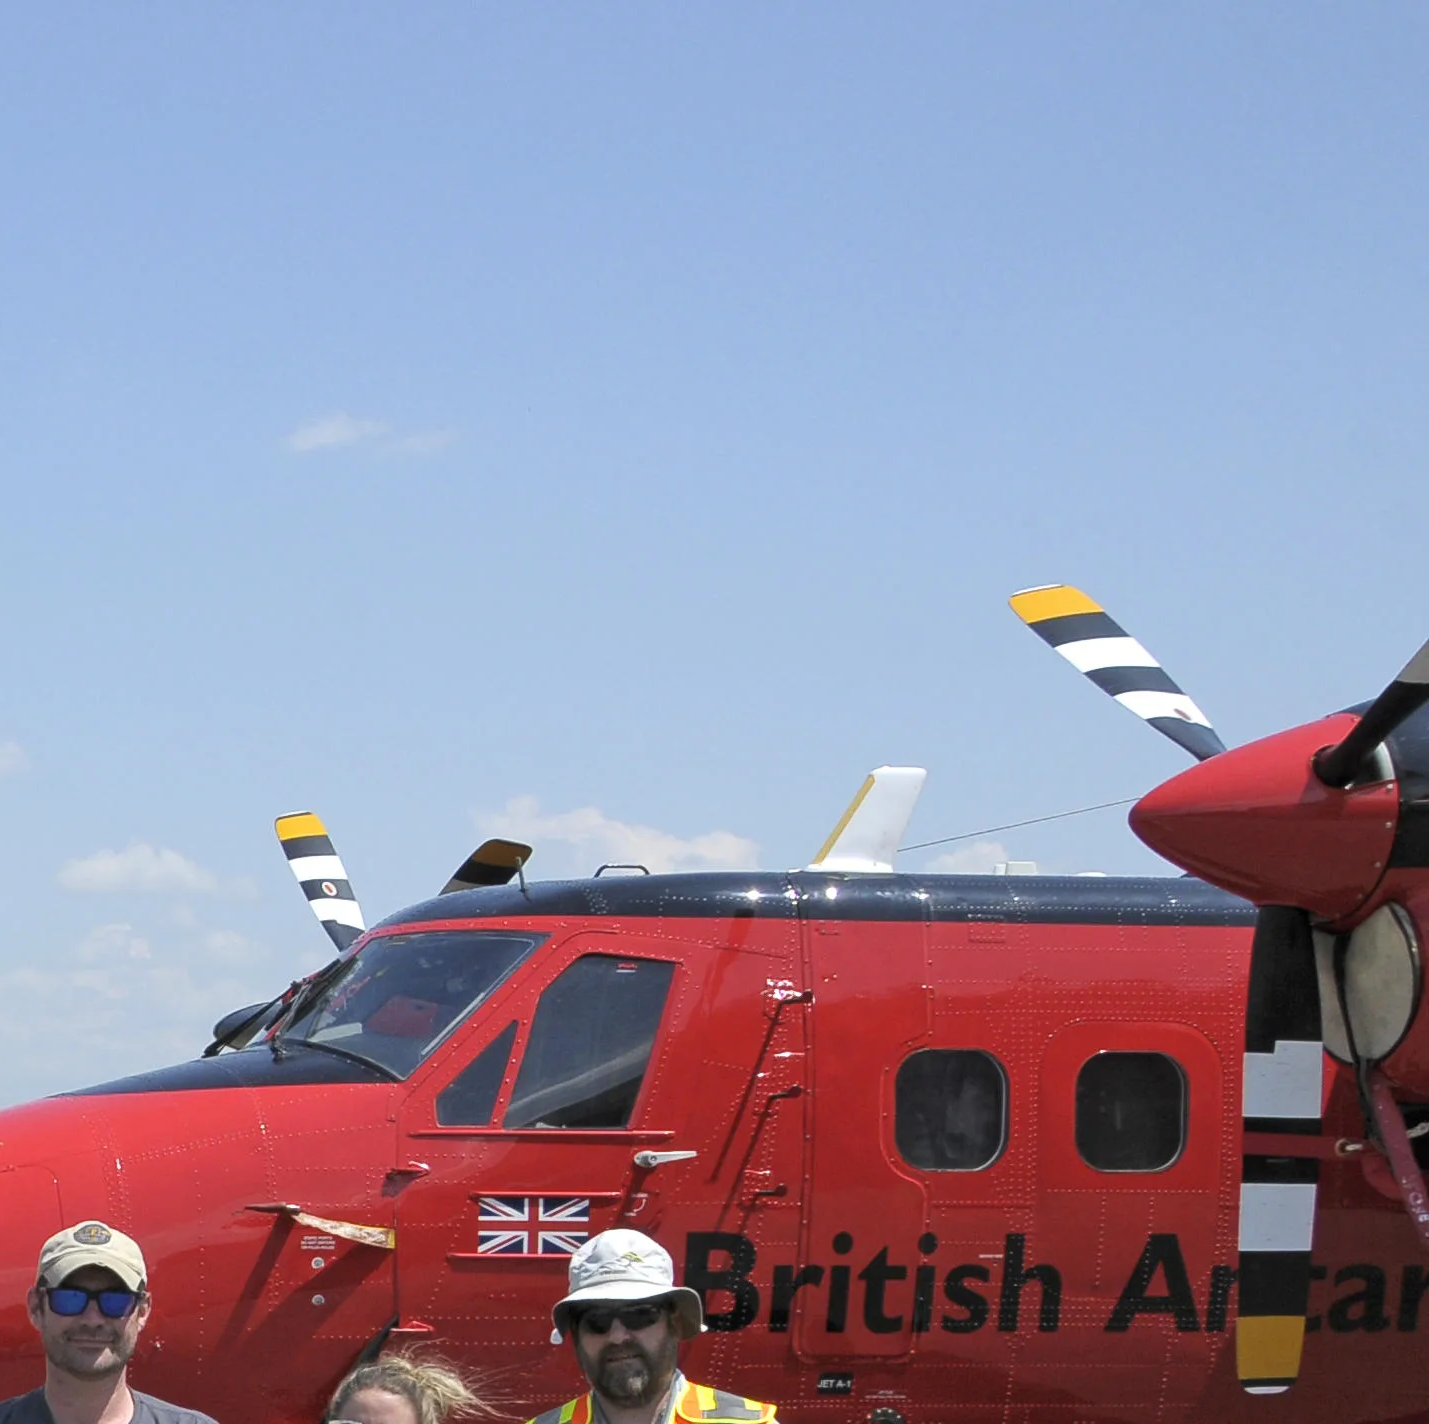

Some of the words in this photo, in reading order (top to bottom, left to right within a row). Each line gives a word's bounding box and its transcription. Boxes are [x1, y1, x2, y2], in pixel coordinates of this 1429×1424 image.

[684, 1232, 1062, 1333] British
[817, 1379, 835, 1388] JET
[836, 1380, 852, 1388] A-1
